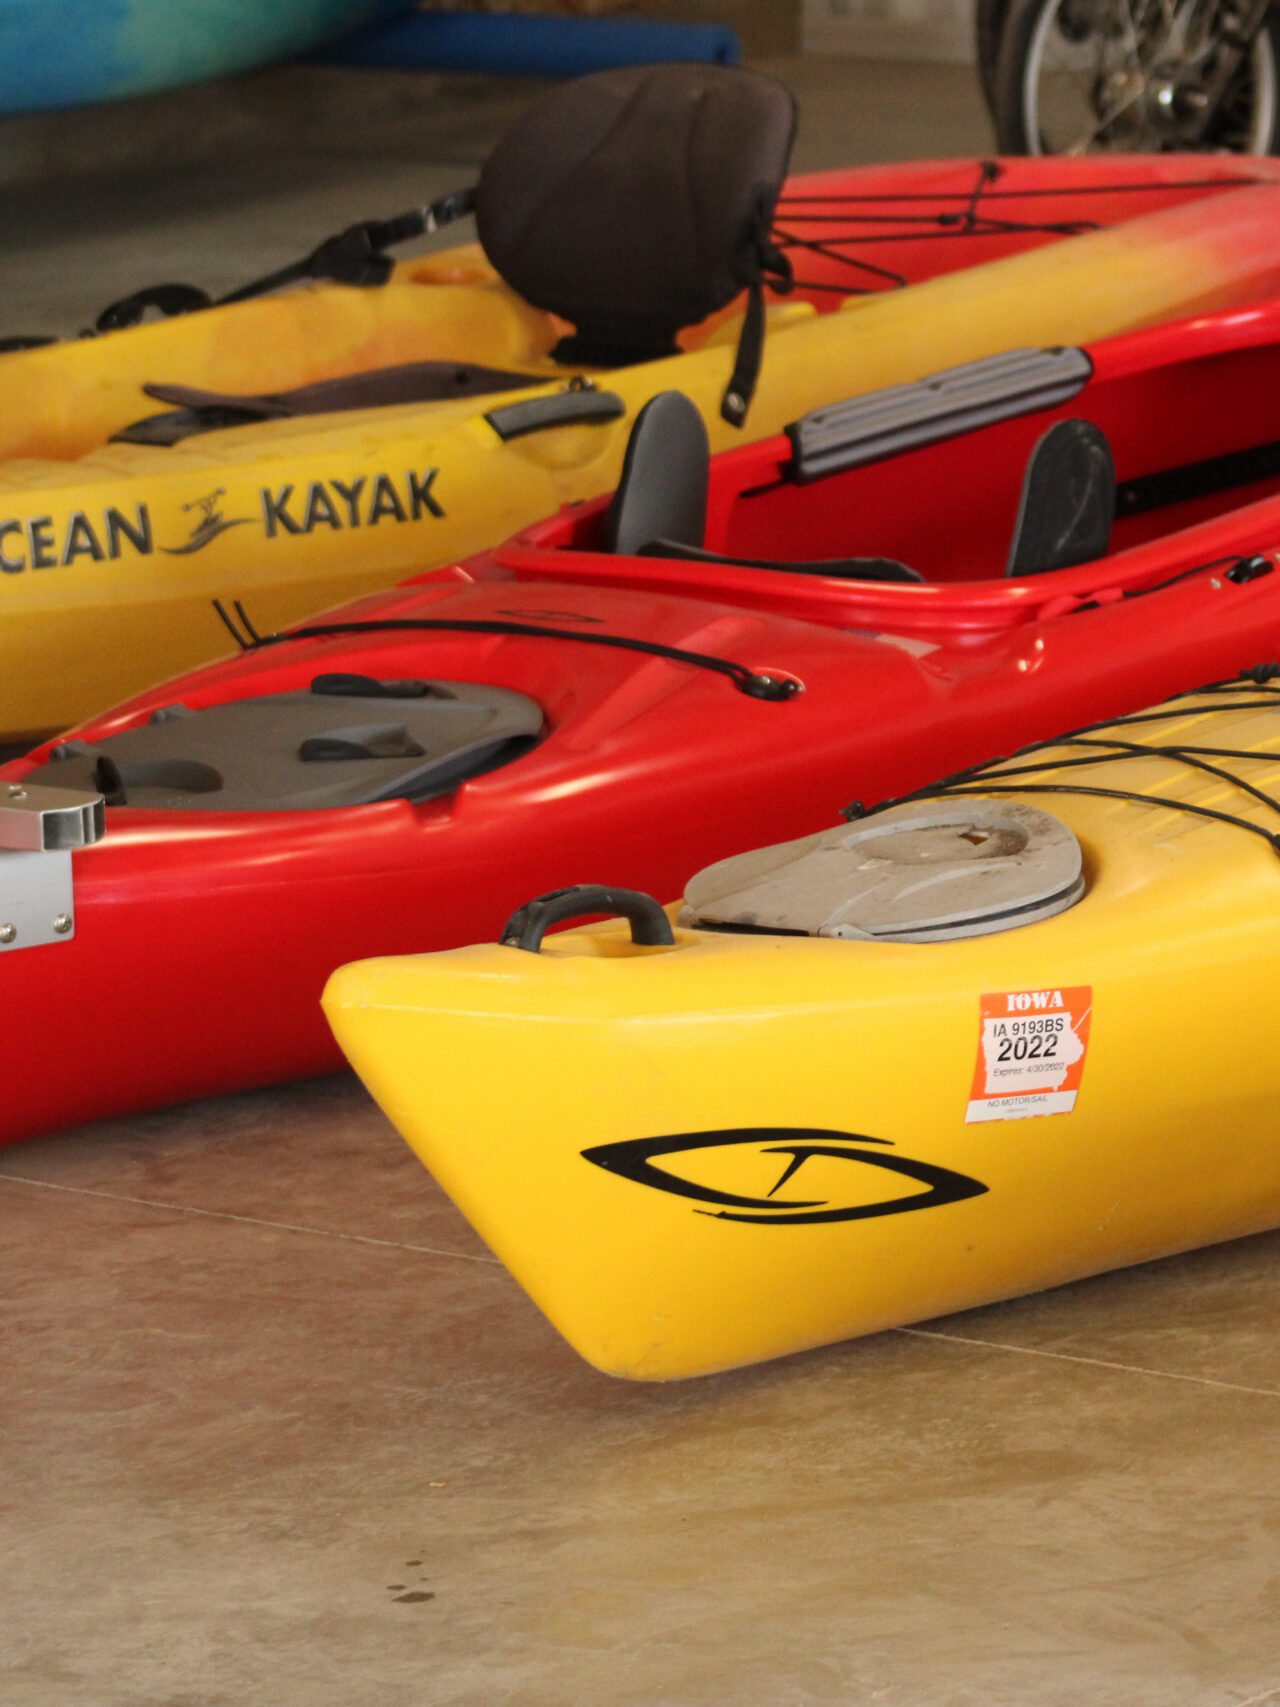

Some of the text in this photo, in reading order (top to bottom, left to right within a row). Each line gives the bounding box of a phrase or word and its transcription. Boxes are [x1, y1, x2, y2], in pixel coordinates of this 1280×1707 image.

[260, 468, 446, 539] KAYAK
[1007, 990, 1064, 1012] IOWA
[993, 1017, 1064, 1037] IA 9193BS
[997, 1034, 1059, 1062] 2022
[1026, 1062, 1065, 1074] 4/30/2022
[987, 1100, 1000, 1108] NO
